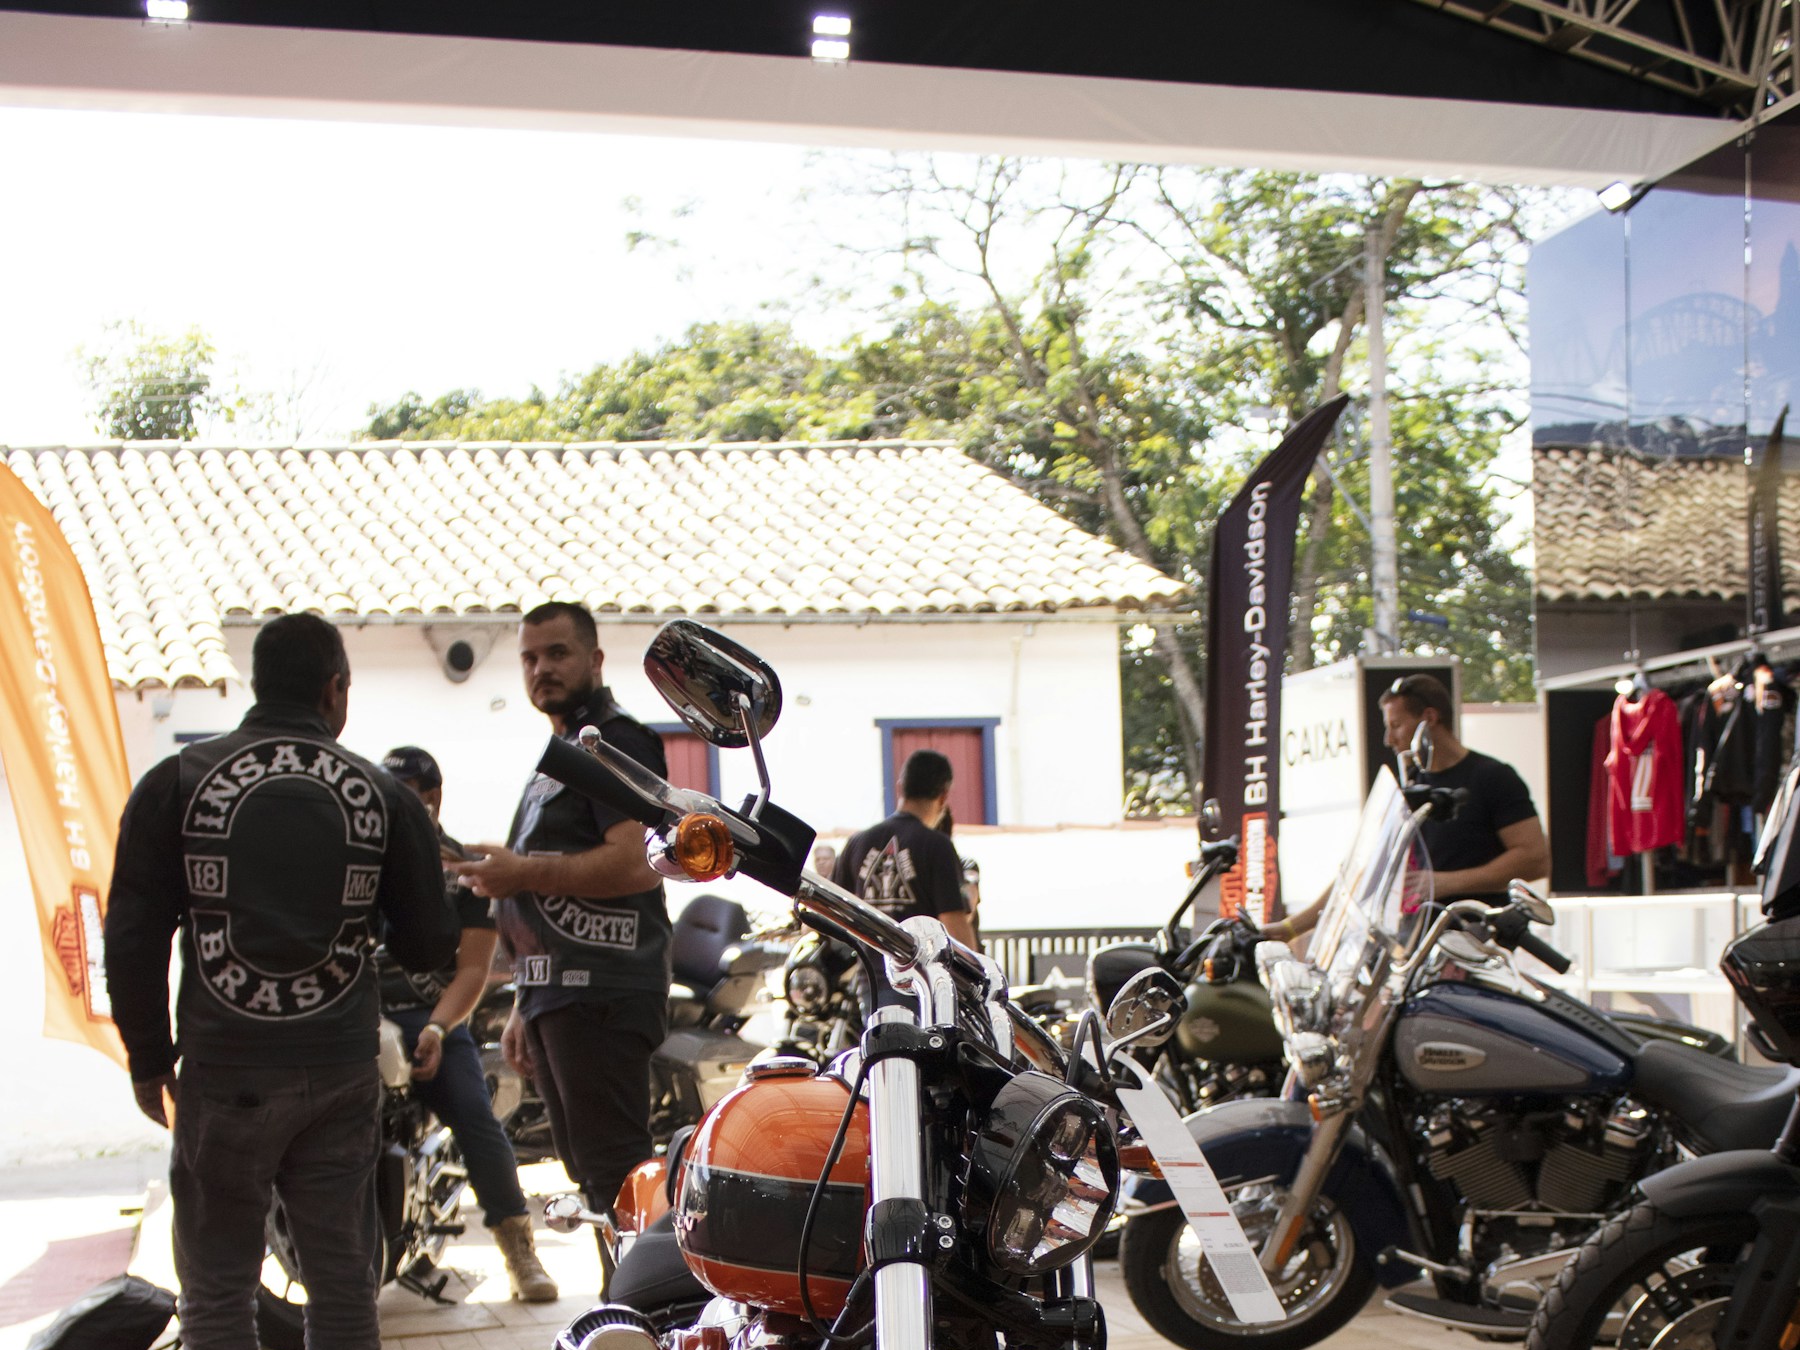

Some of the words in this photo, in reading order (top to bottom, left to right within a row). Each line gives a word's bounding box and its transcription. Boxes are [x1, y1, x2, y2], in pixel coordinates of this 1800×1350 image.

[1243, 480, 1272, 747] Harley-Davidson
[1284, 717, 1351, 767] CAIXA
[194, 744, 383, 840] INSANOS
[1244, 755, 1268, 806] BH
[64, 820, 90, 872] BH
[192, 861, 220, 892] 18
[349, 872, 378, 899] MC
[557, 905, 635, 944] FORTE
[199, 928, 364, 1014] BRASIL
[531, 961, 545, 981] VI
